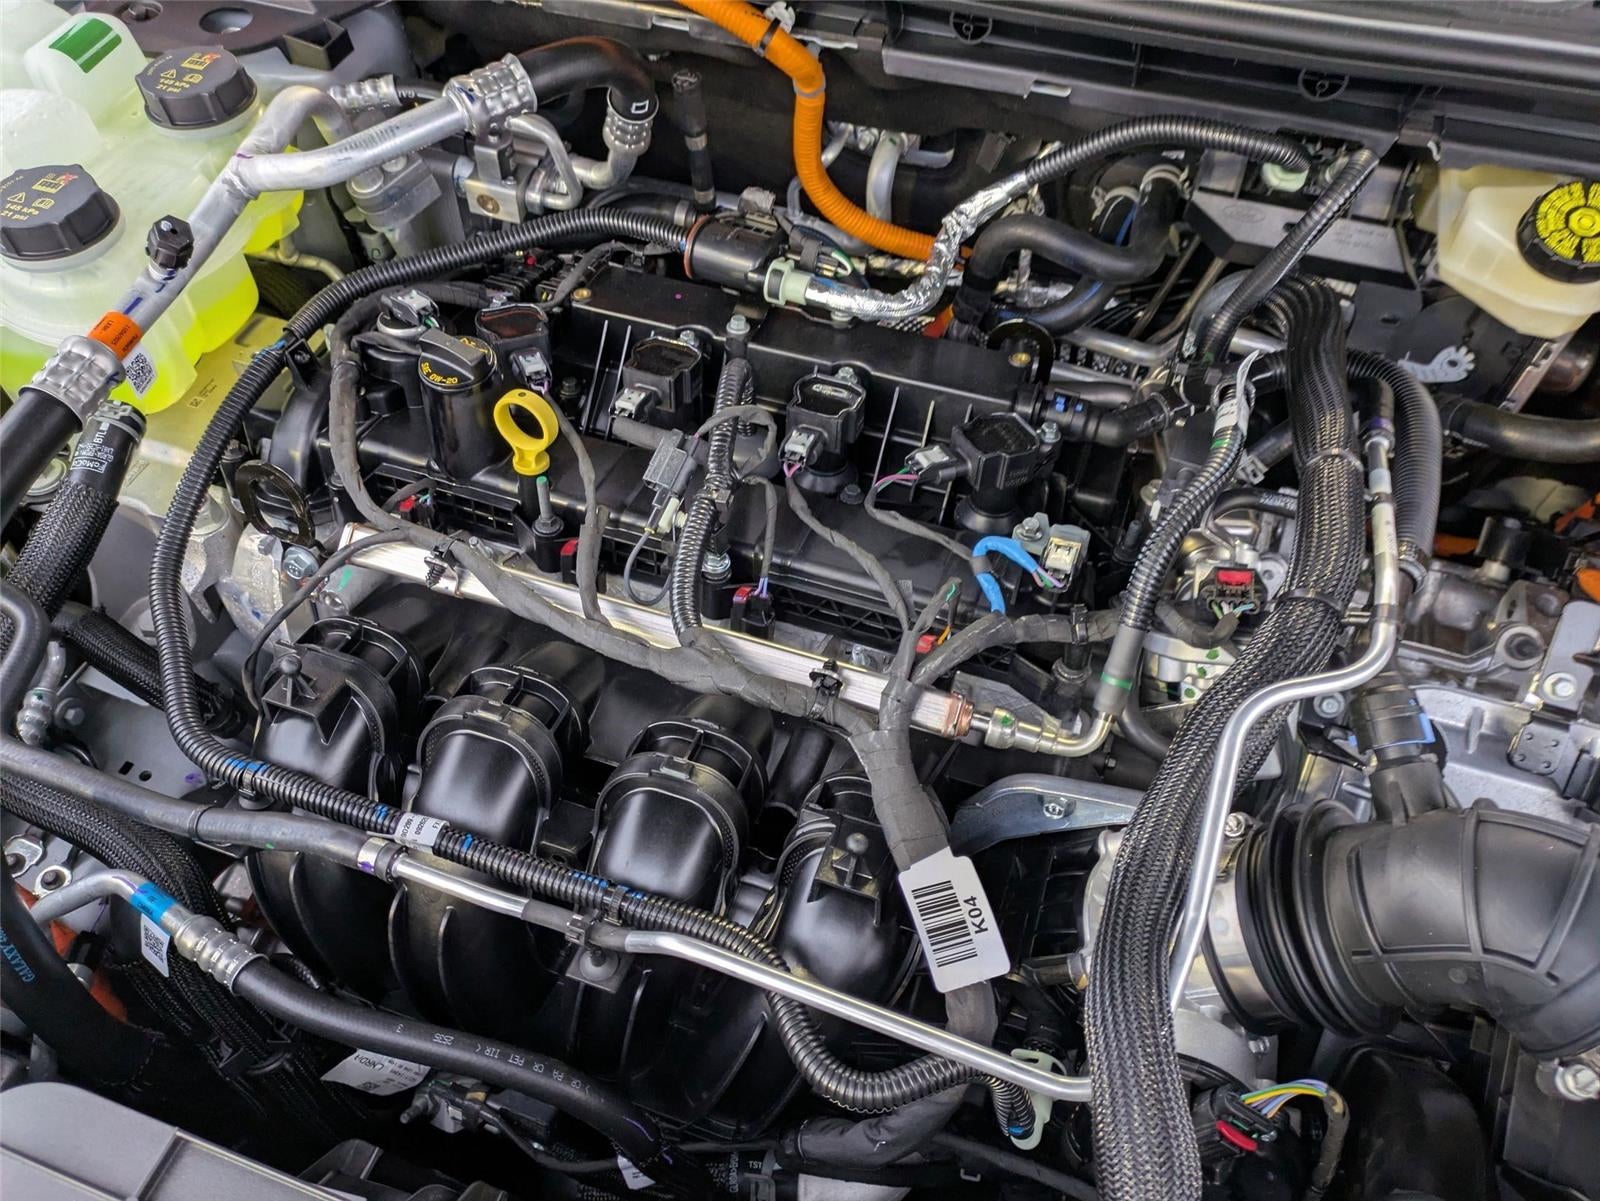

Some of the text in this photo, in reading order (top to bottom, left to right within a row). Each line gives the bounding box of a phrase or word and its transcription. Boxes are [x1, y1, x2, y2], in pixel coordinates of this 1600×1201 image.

[421, 362, 458, 384] SAE 0W-20
[963, 895, 988, 934] K04
[508, 1053, 525, 1067] PET
[532, 1062, 545, 1073] CR
[552, 1069, 565, 1082] PA
